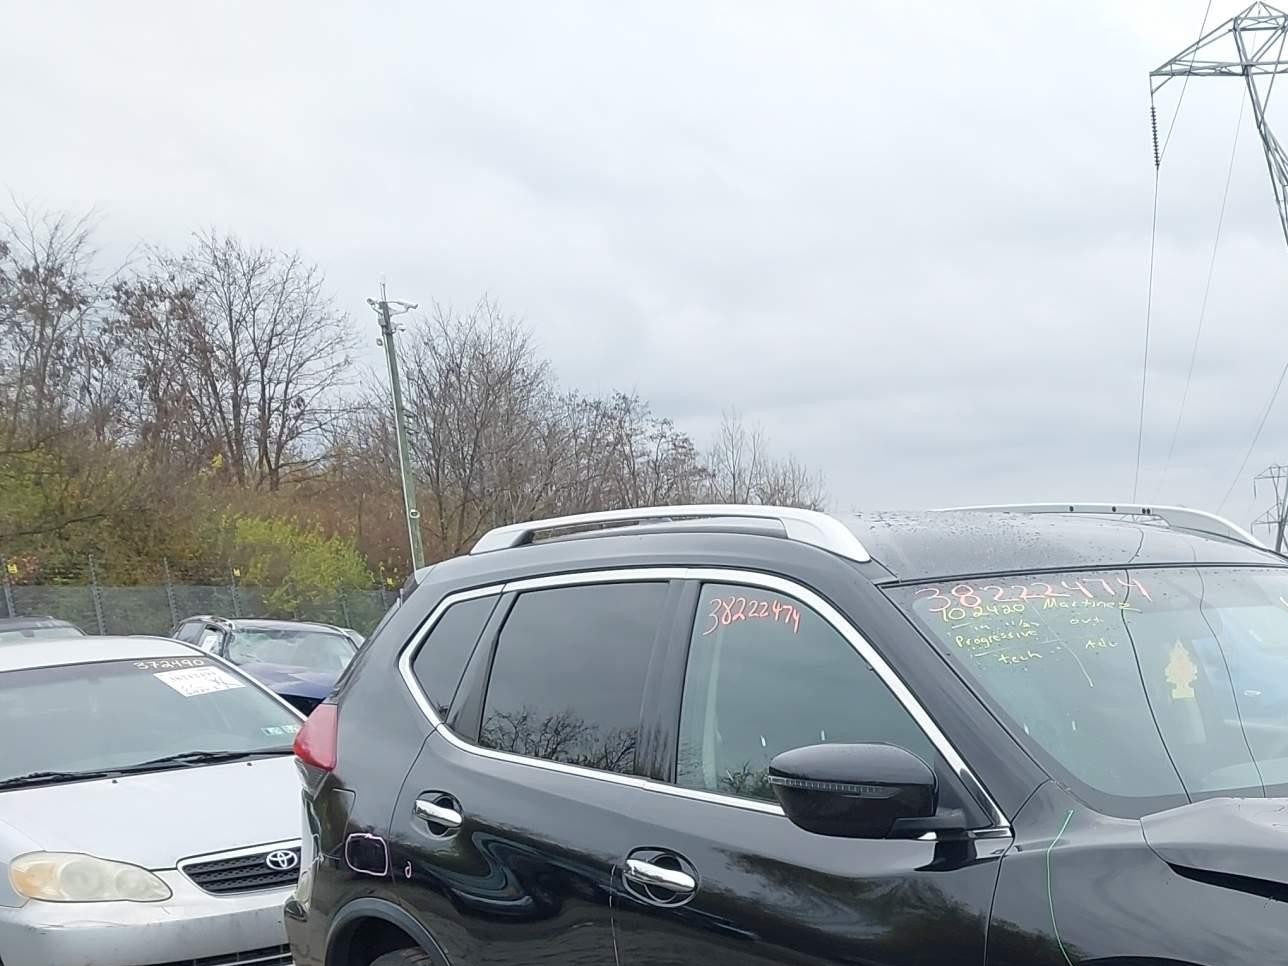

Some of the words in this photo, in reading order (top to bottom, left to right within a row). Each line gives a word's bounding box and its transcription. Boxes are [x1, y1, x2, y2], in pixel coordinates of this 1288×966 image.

[914, 577, 1152, 613] 38222474
[702, 596, 801, 636] 38222474
[132, 659, 205, 670] 372490
